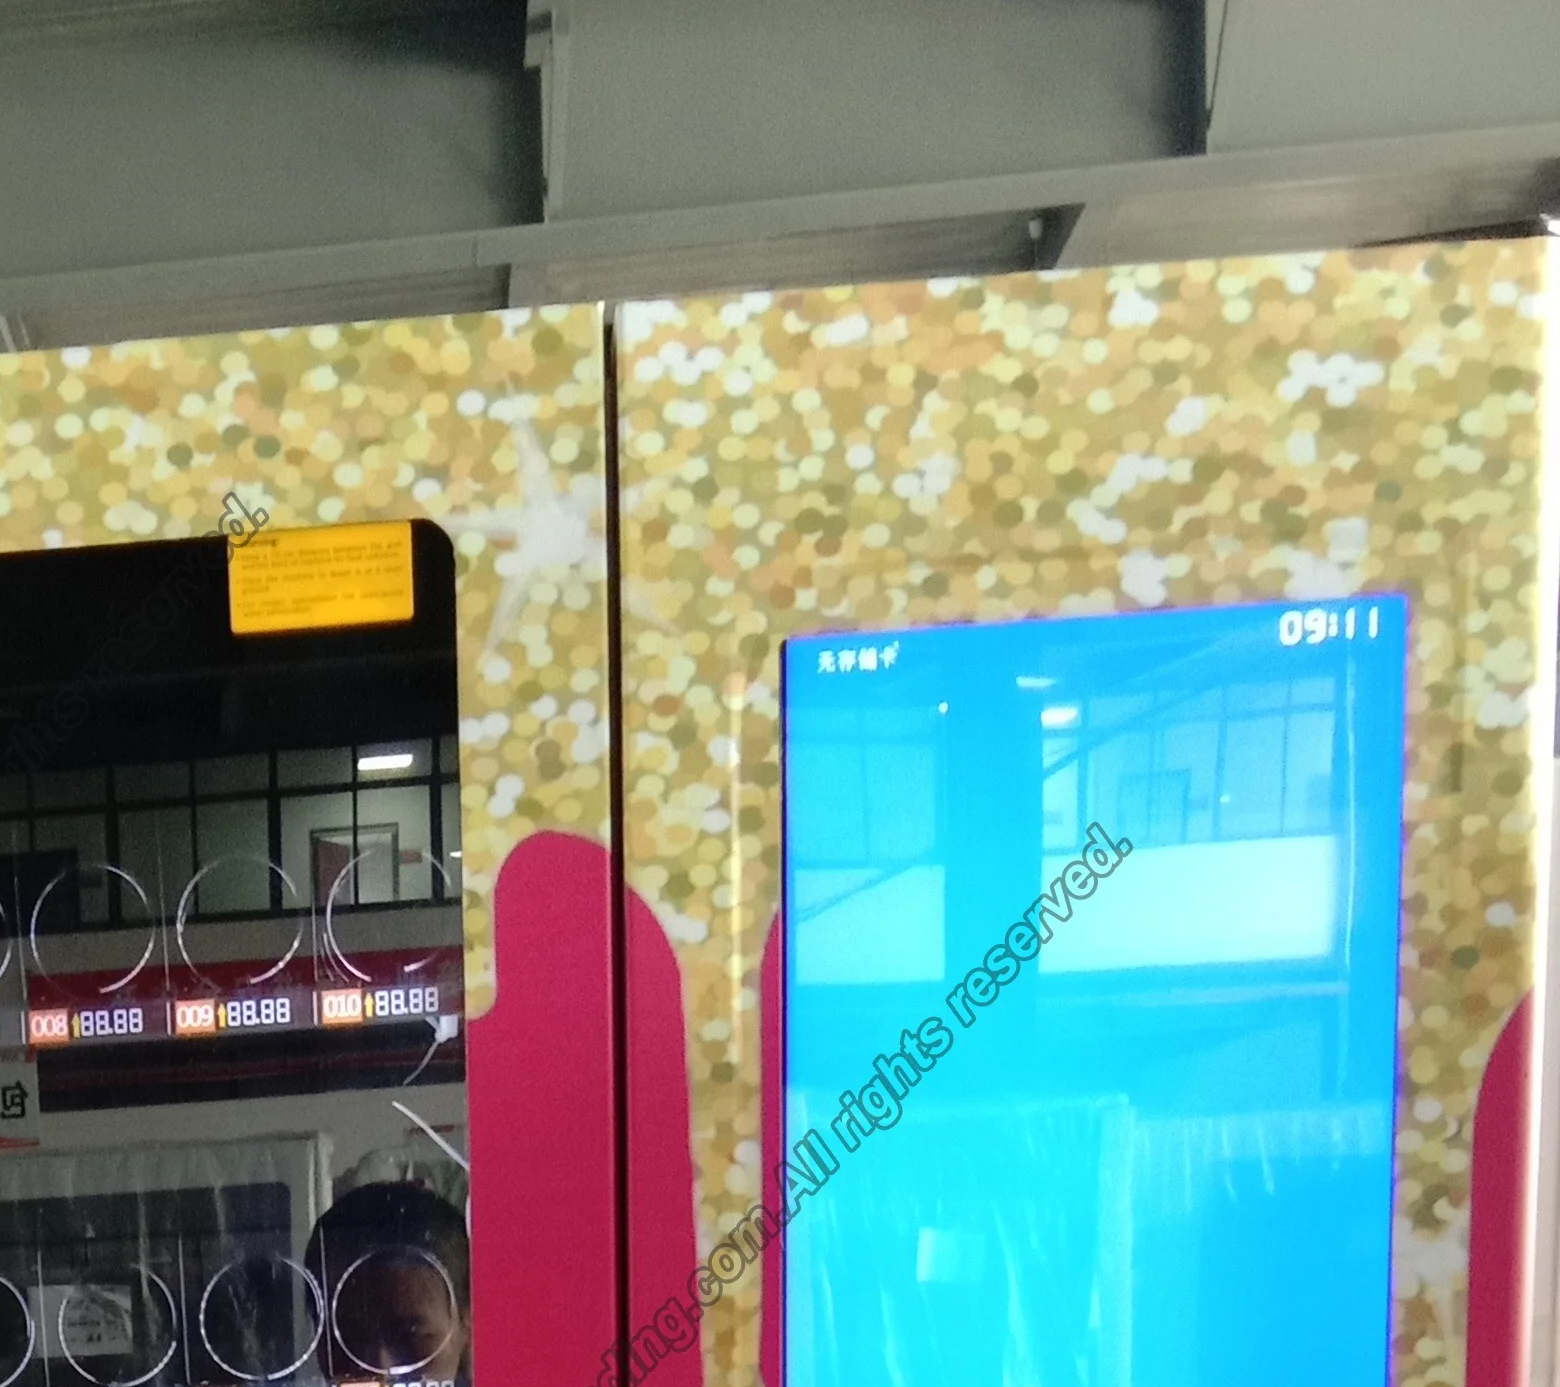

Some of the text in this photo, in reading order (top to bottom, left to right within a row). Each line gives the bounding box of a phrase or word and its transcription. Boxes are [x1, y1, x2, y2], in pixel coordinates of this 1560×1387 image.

[1279, 606, 1379, 646] 09:11
[177, 998, 290, 1028] 009 88.88
[324, 987, 439, 1018] 010 88.88
[32, 1008, 143, 1038] 008 88.88
